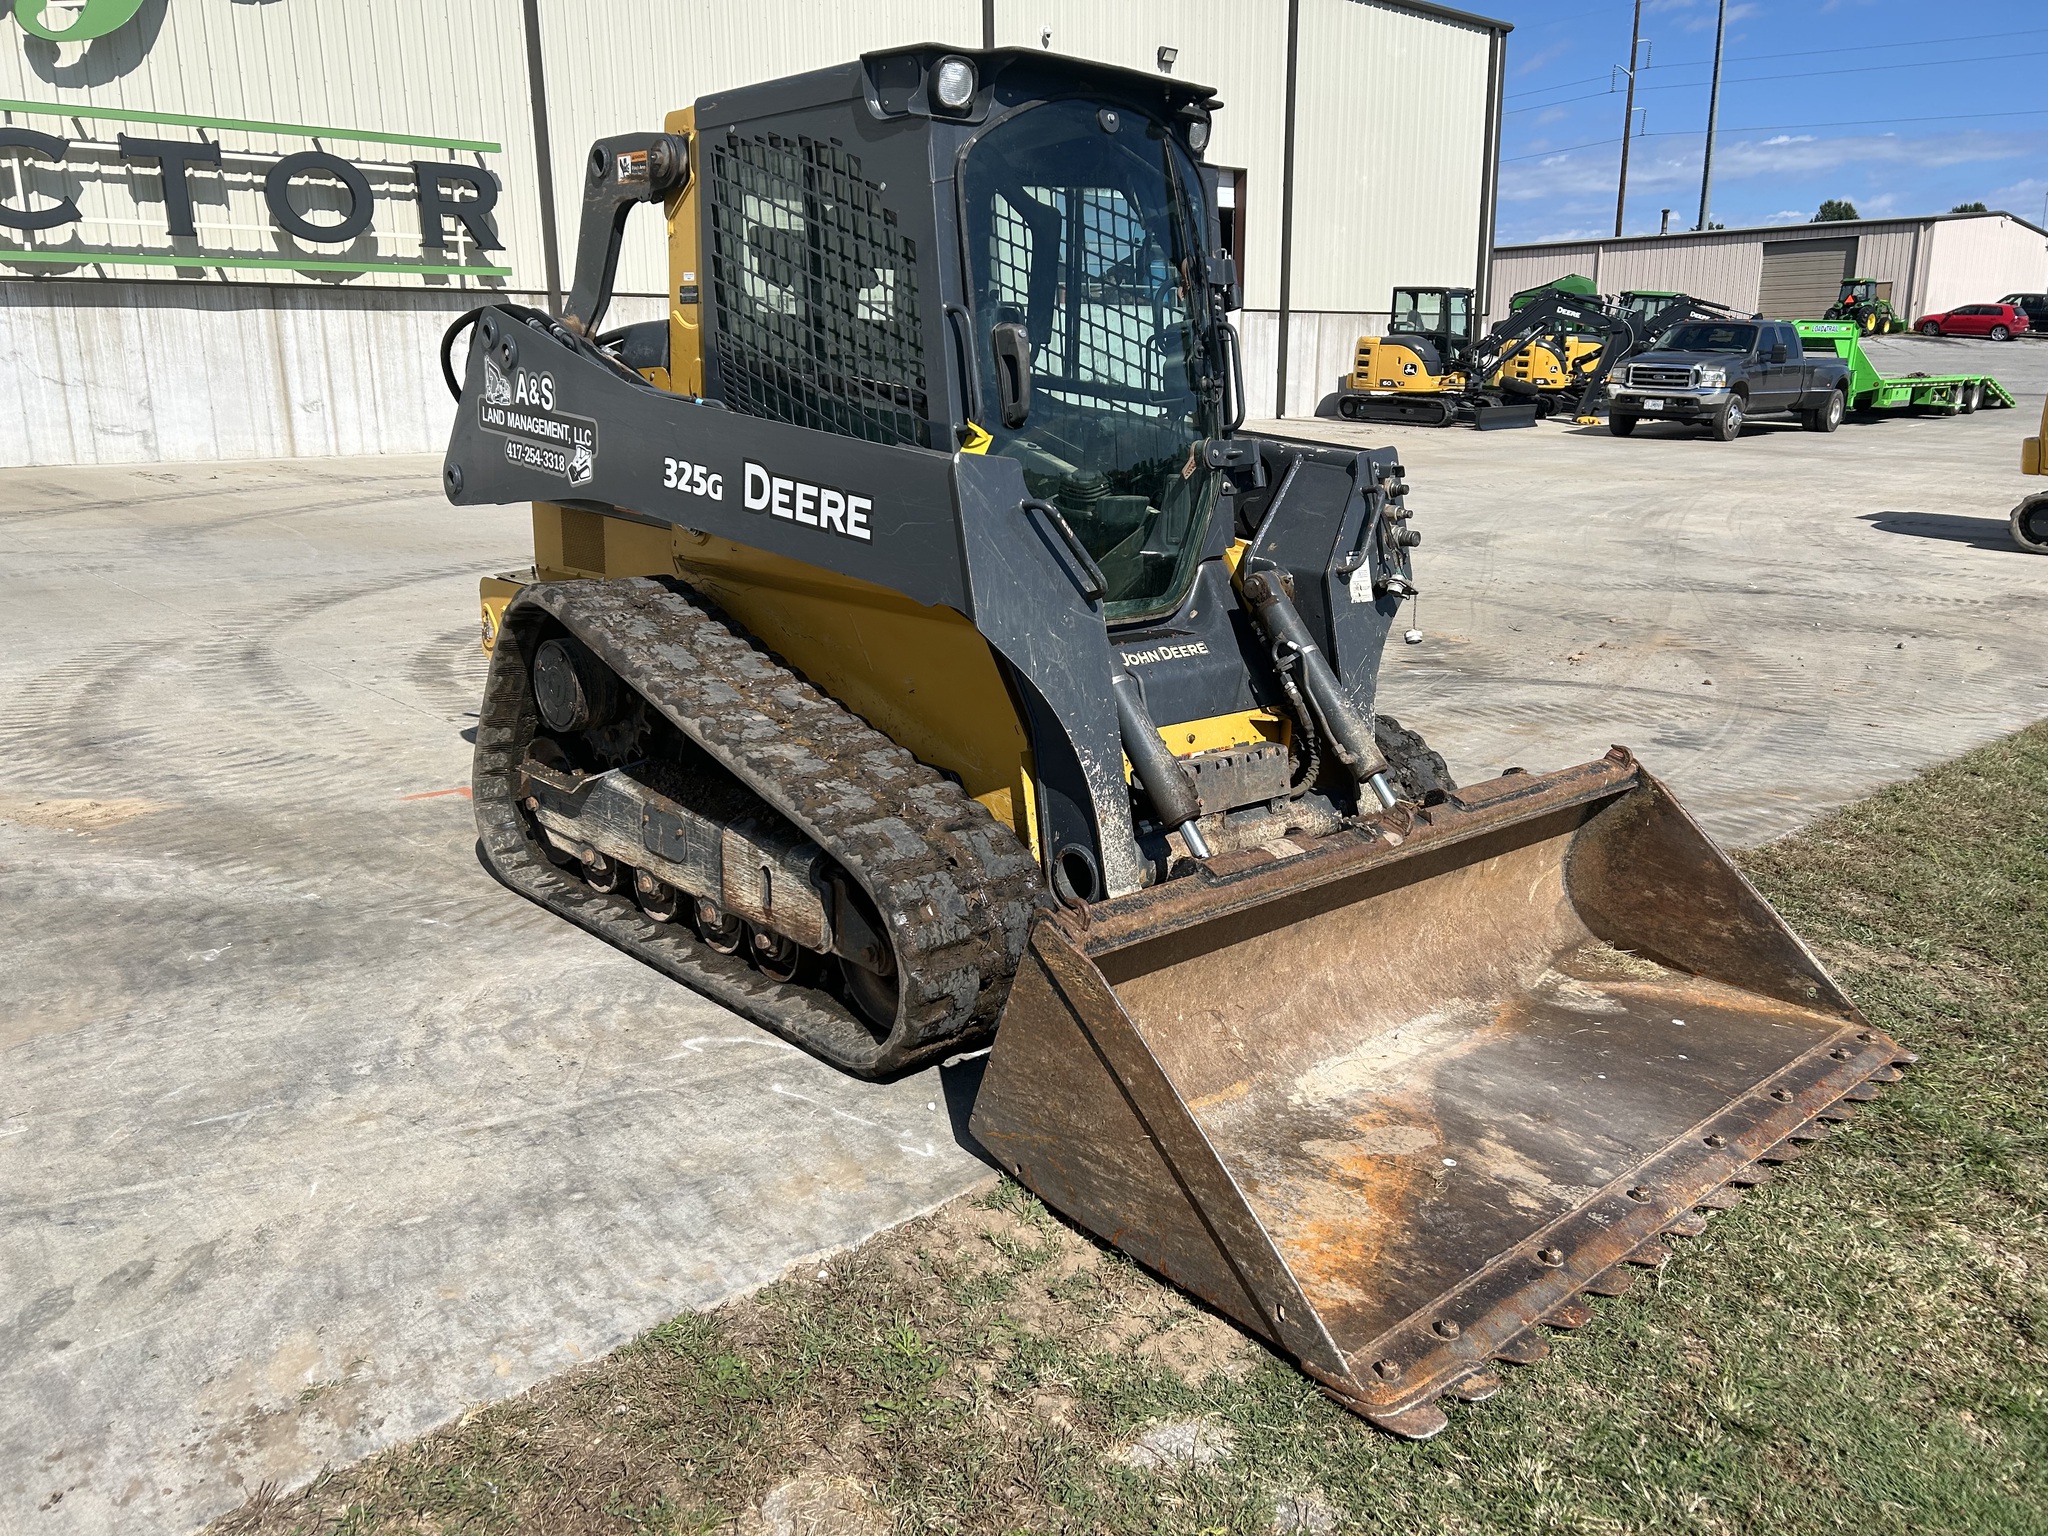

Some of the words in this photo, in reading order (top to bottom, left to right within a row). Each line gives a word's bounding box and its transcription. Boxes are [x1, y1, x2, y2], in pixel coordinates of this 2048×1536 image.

[1556, 306, 1582, 319] DEERE
[515, 373, 554, 411] A&S
[482, 406, 505, 425] LAND
[507, 413, 571, 444] MANAGEMENT,
[573, 427, 592, 446] LLC
[506, 442, 565, 472] 417-254-3318
[663, 457, 723, 501] 325G
[744, 461, 873, 541] DEERE
[1120, 649, 1161, 667] JOHN
[1158, 641, 1209, 660] DEERE
